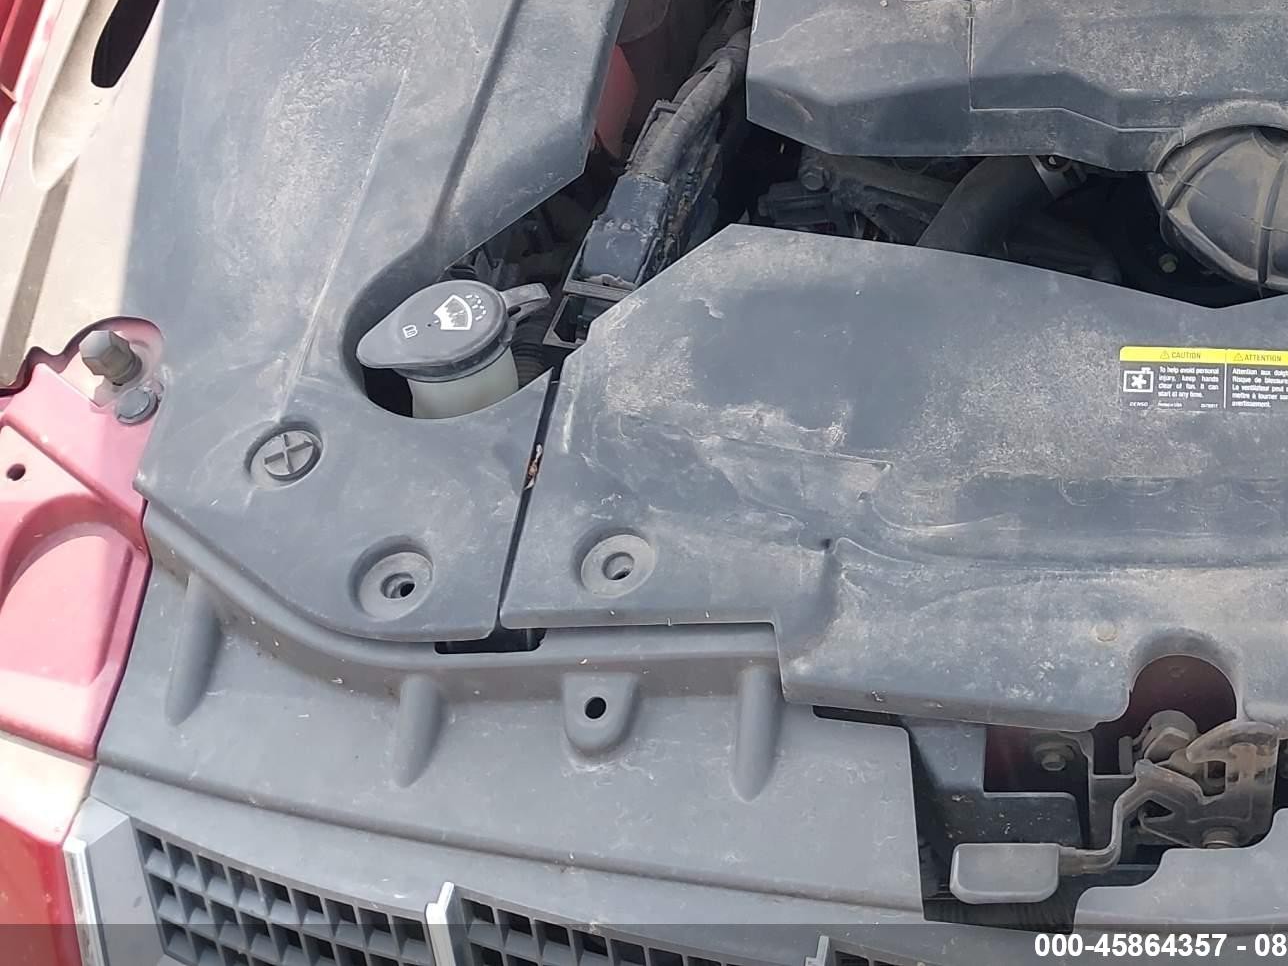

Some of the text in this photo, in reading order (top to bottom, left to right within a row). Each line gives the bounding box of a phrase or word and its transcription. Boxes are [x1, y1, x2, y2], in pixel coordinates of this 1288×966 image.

[1244, 354, 1282, 362] ATTENTION
[1167, 366, 1179, 375] help
[1182, 375, 1196, 383] keep
